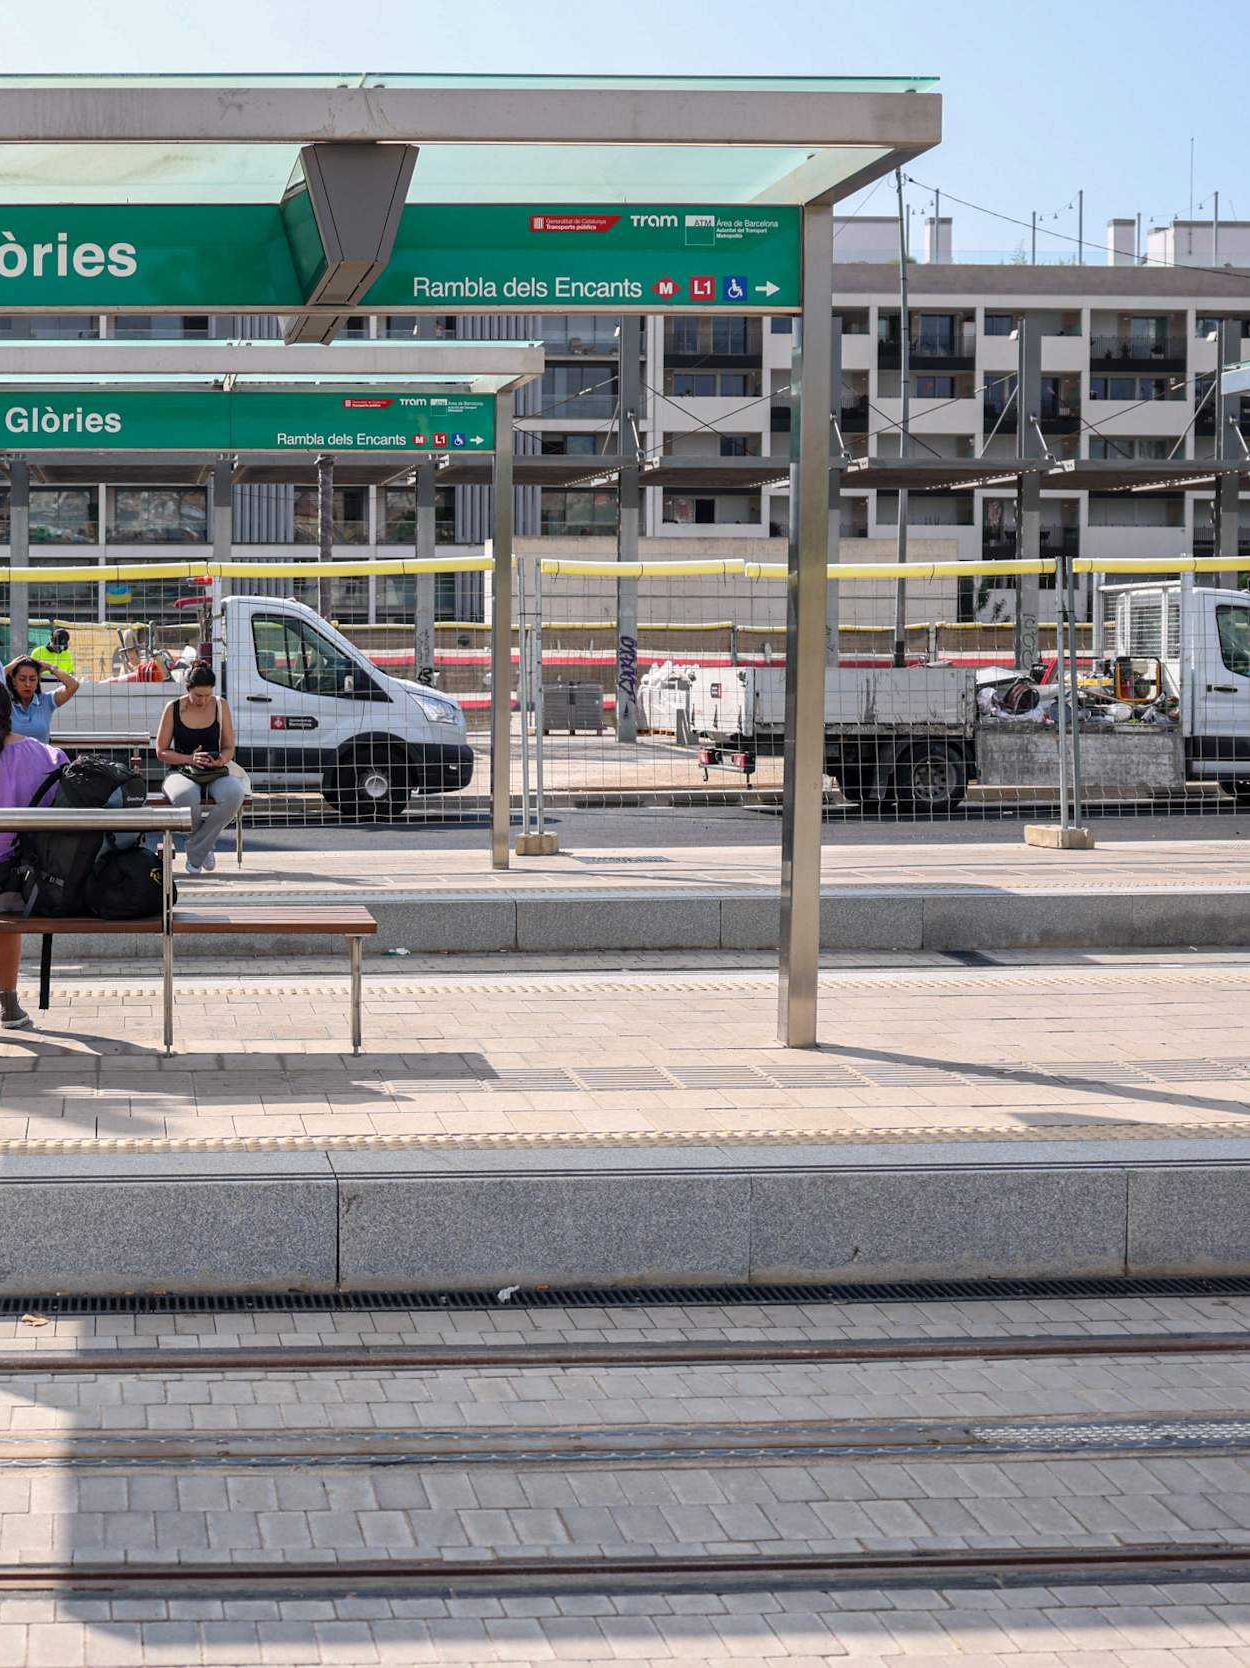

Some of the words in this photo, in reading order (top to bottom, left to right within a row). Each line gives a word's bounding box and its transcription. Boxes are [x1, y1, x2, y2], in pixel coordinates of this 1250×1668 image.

[694, 219, 712, 228] ATM
[733, 219, 743, 227] de
[744, 219, 779, 228] Barcelona
[413, 277, 498, 298] Rambla
[503, 277, 548, 298] dels
[554, 277, 643, 298] Encants
[659, 281, 674, 295] M
[694, 280, 712, 295] L1
[5, 406, 122, 433] Glòries
[277, 433, 325, 445] Rambla
[328, 433, 353, 445] dels
[357, 433, 406, 445] Encants
[435, 435, 445, 444] L1
